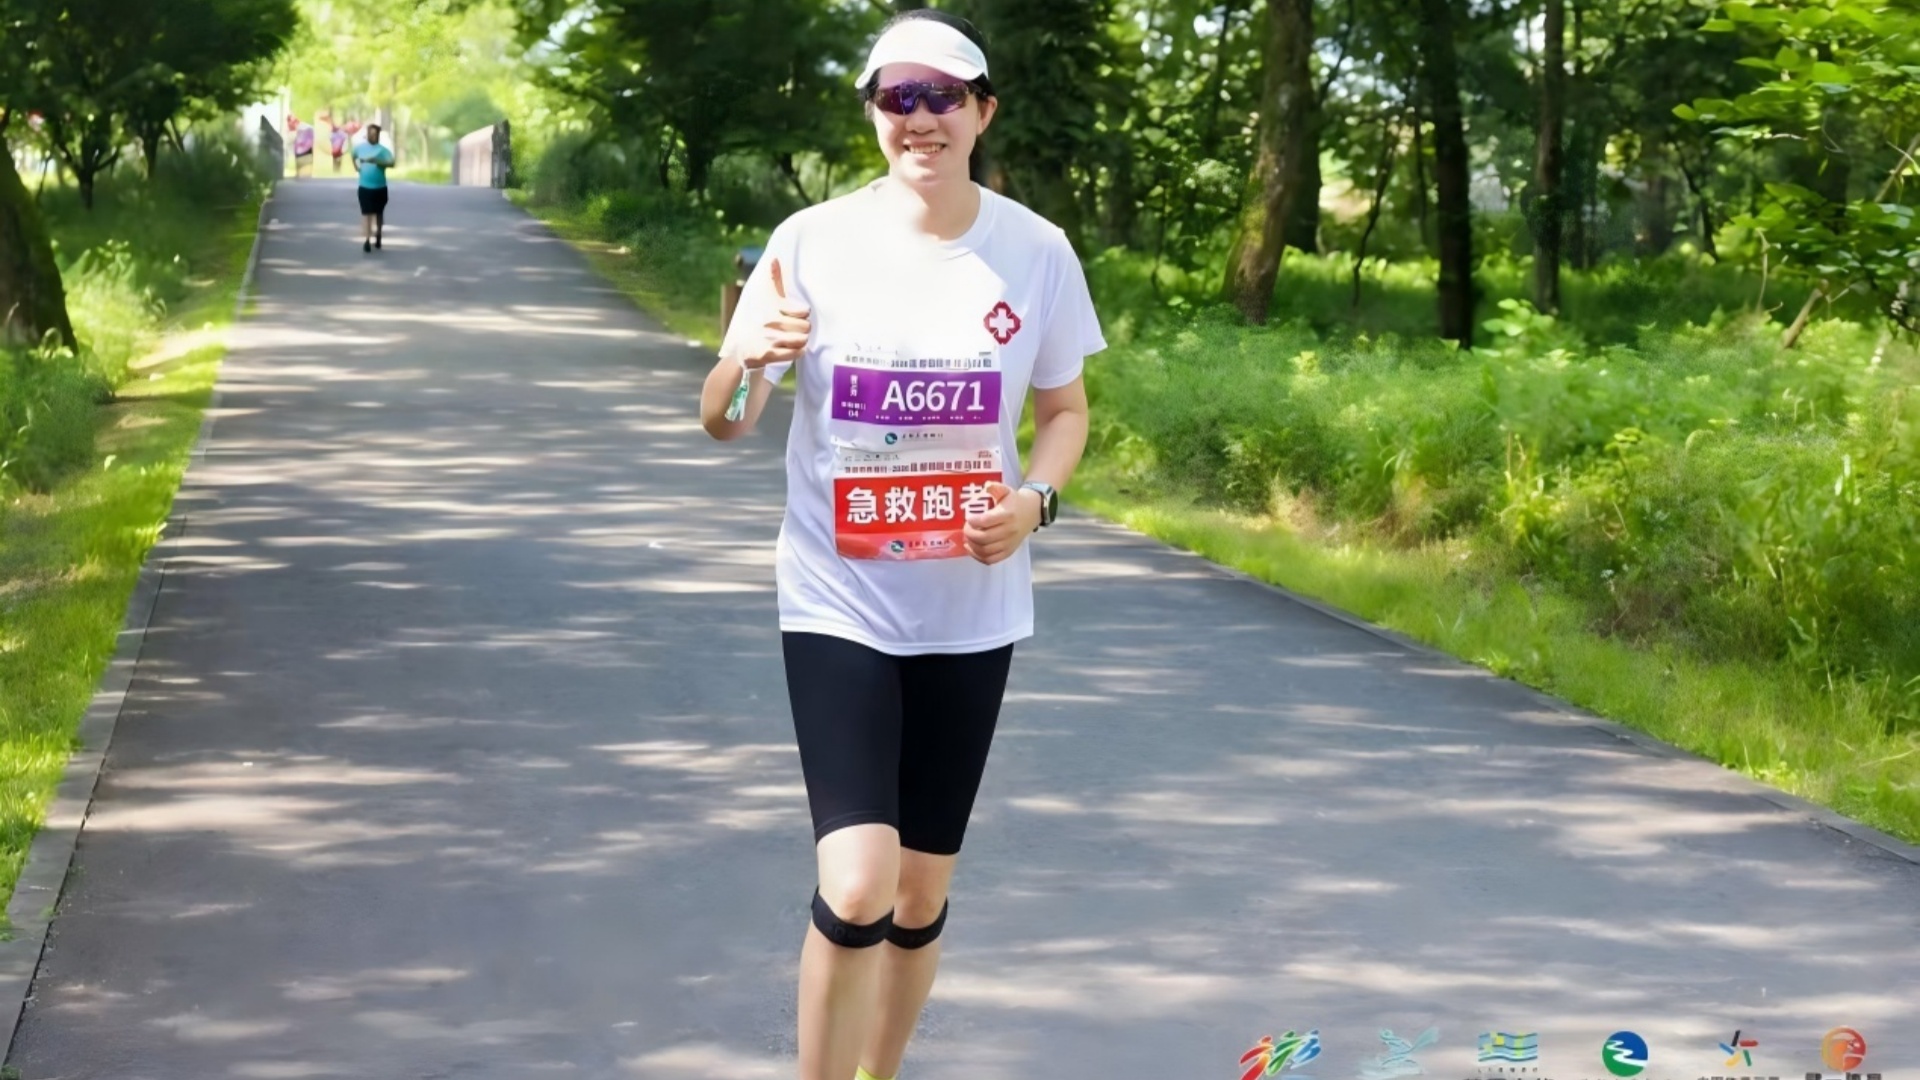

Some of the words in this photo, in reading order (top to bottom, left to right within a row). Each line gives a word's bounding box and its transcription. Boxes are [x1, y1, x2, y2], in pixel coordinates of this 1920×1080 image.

[881, 380, 985, 411] A6671
[846, 482, 994, 524] 急救跑者
